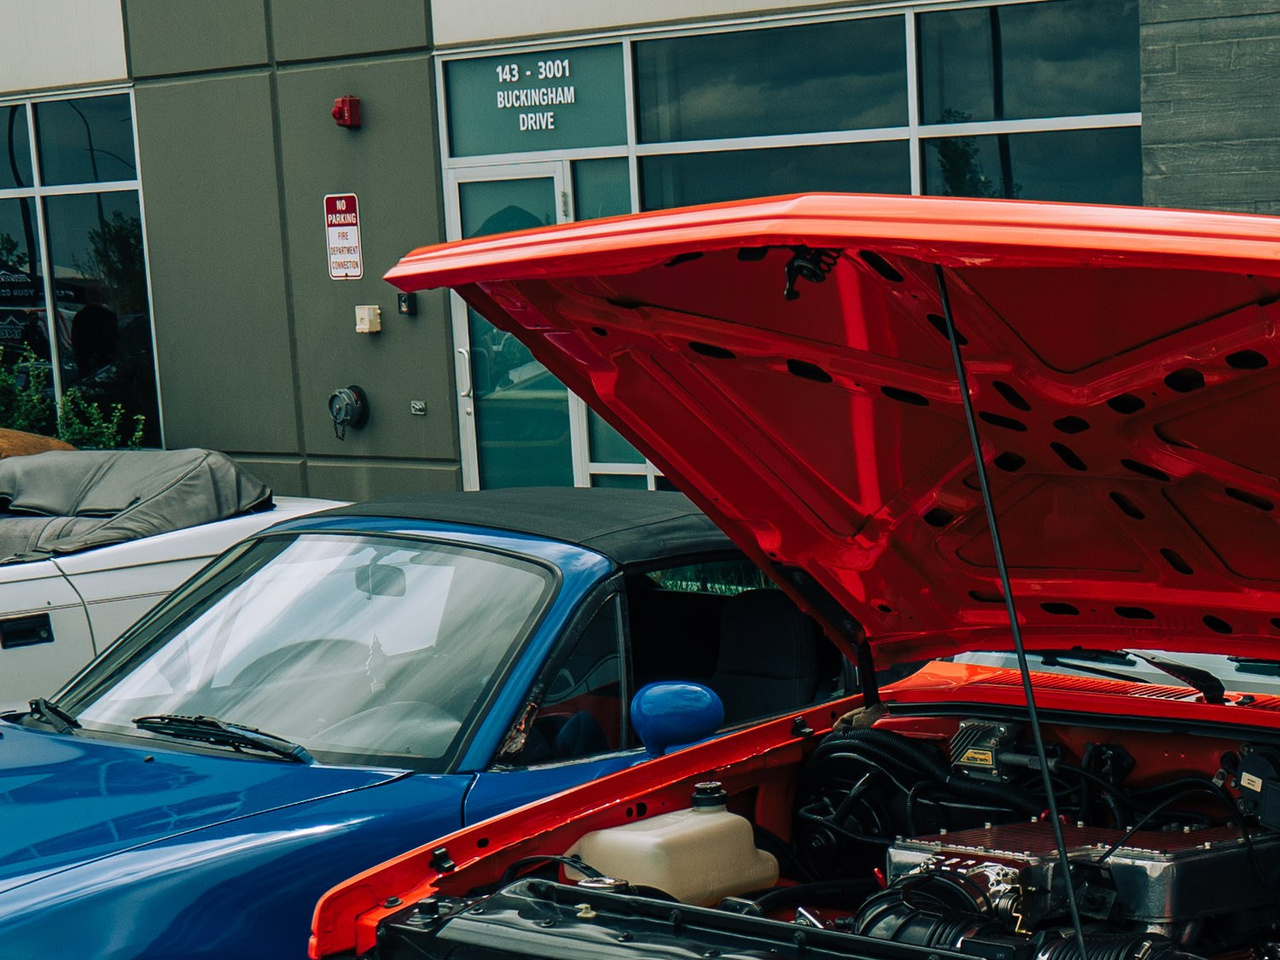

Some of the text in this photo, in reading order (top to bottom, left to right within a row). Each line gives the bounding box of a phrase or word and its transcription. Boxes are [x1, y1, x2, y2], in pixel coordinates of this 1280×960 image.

[496, 64, 519, 82] 143
[538, 59, 570, 79] 3001
[497, 86, 575, 108] BUCKINGHAM
[519, 112, 555, 131] DRIVE
[336, 200, 346, 210] NO
[328, 213, 357, 224] PARKING
[338, 232, 349, 241] FIRE
[331, 246, 359, 255] DEPARTMENT
[332, 261, 359, 270] CONNECTION
